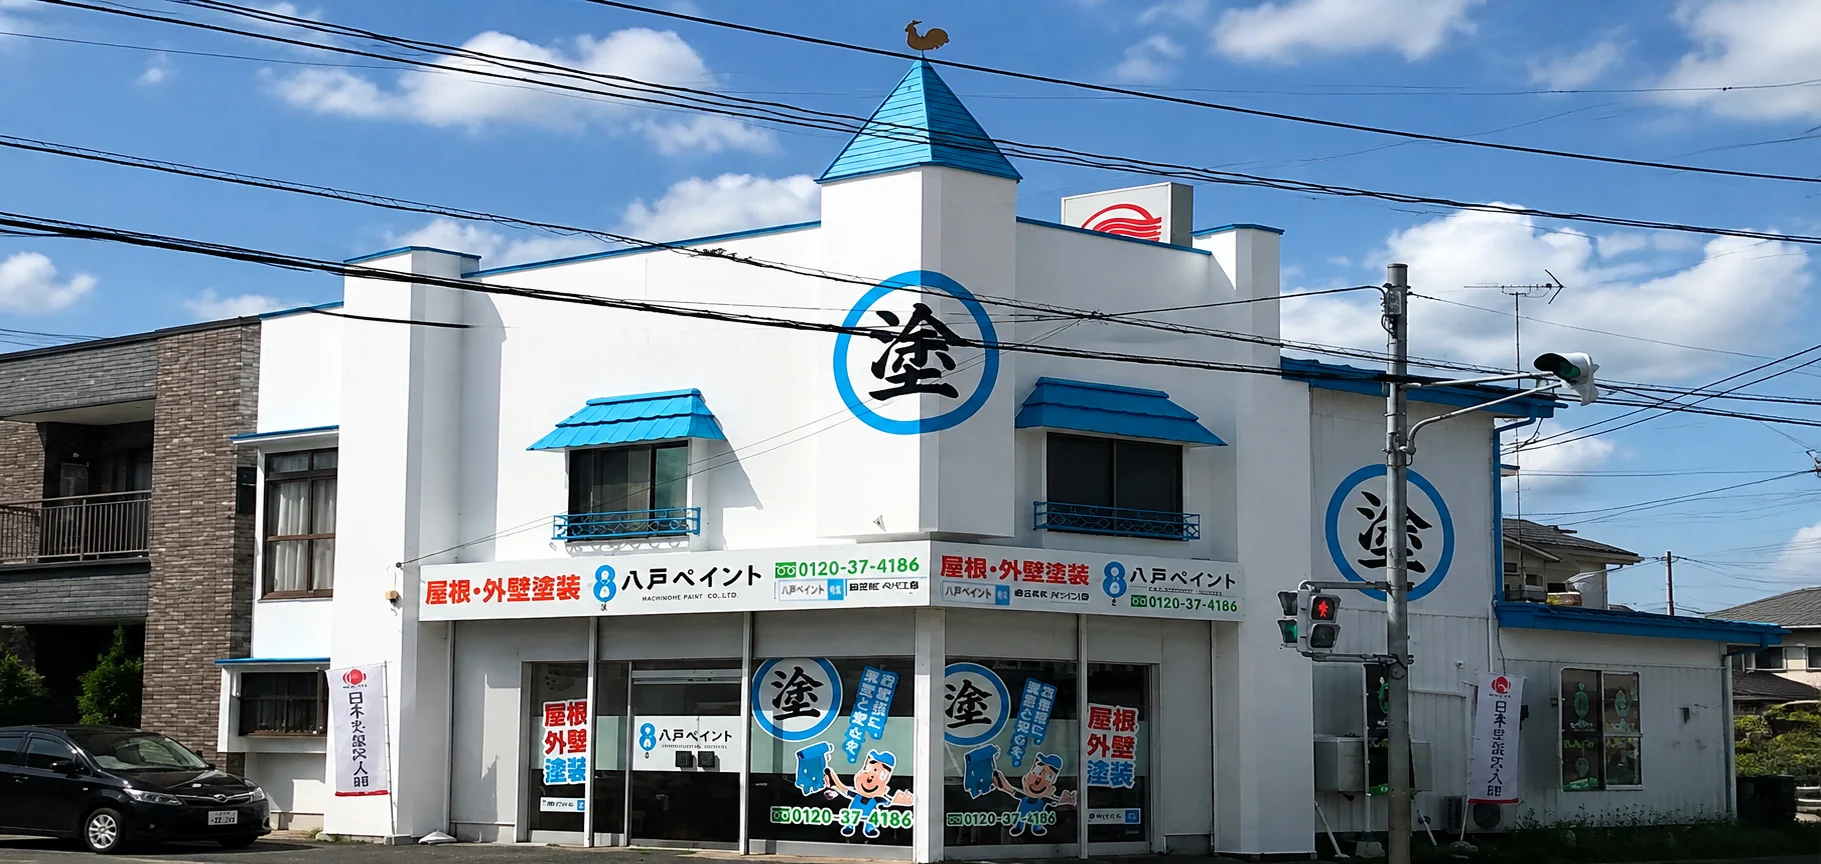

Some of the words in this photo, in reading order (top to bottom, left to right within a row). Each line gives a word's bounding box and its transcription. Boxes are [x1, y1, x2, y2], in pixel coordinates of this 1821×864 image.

[868, 302, 960, 401] 塗
[1355, 490, 1433, 574] 塗
[621, 564, 763, 591] 八戸ペイント
[799, 557, 920, 577] 0120-37-4186
[940, 555, 1090, 586] 屋根・外壁塗装
[1130, 567, 1236, 589] 八戸ペイント
[425, 574, 581, 605] 屋根・外壁塗装
[781, 584, 825, 596] 八戸ペイント
[945, 586, 992, 600] 八戸ペイント
[1148, 595, 1238, 612] 0120-37-4186
[771, 666, 824, 721] 塗
[944, 679, 993, 729] 塗
[544, 701, 587, 727] 屋根
[1087, 706, 1136, 732] 屋根
[544, 729, 587, 755] 外壁
[658, 729, 733, 743] 八戸ペイント
[1087, 733, 1136, 760] 外壁
[545, 756, 586, 783] 塗装
[1087, 760, 1135, 787] 塗装
[792, 808, 912, 827] 0120-37-4186
[964, 811, 1057, 826] 0120-37-4186
